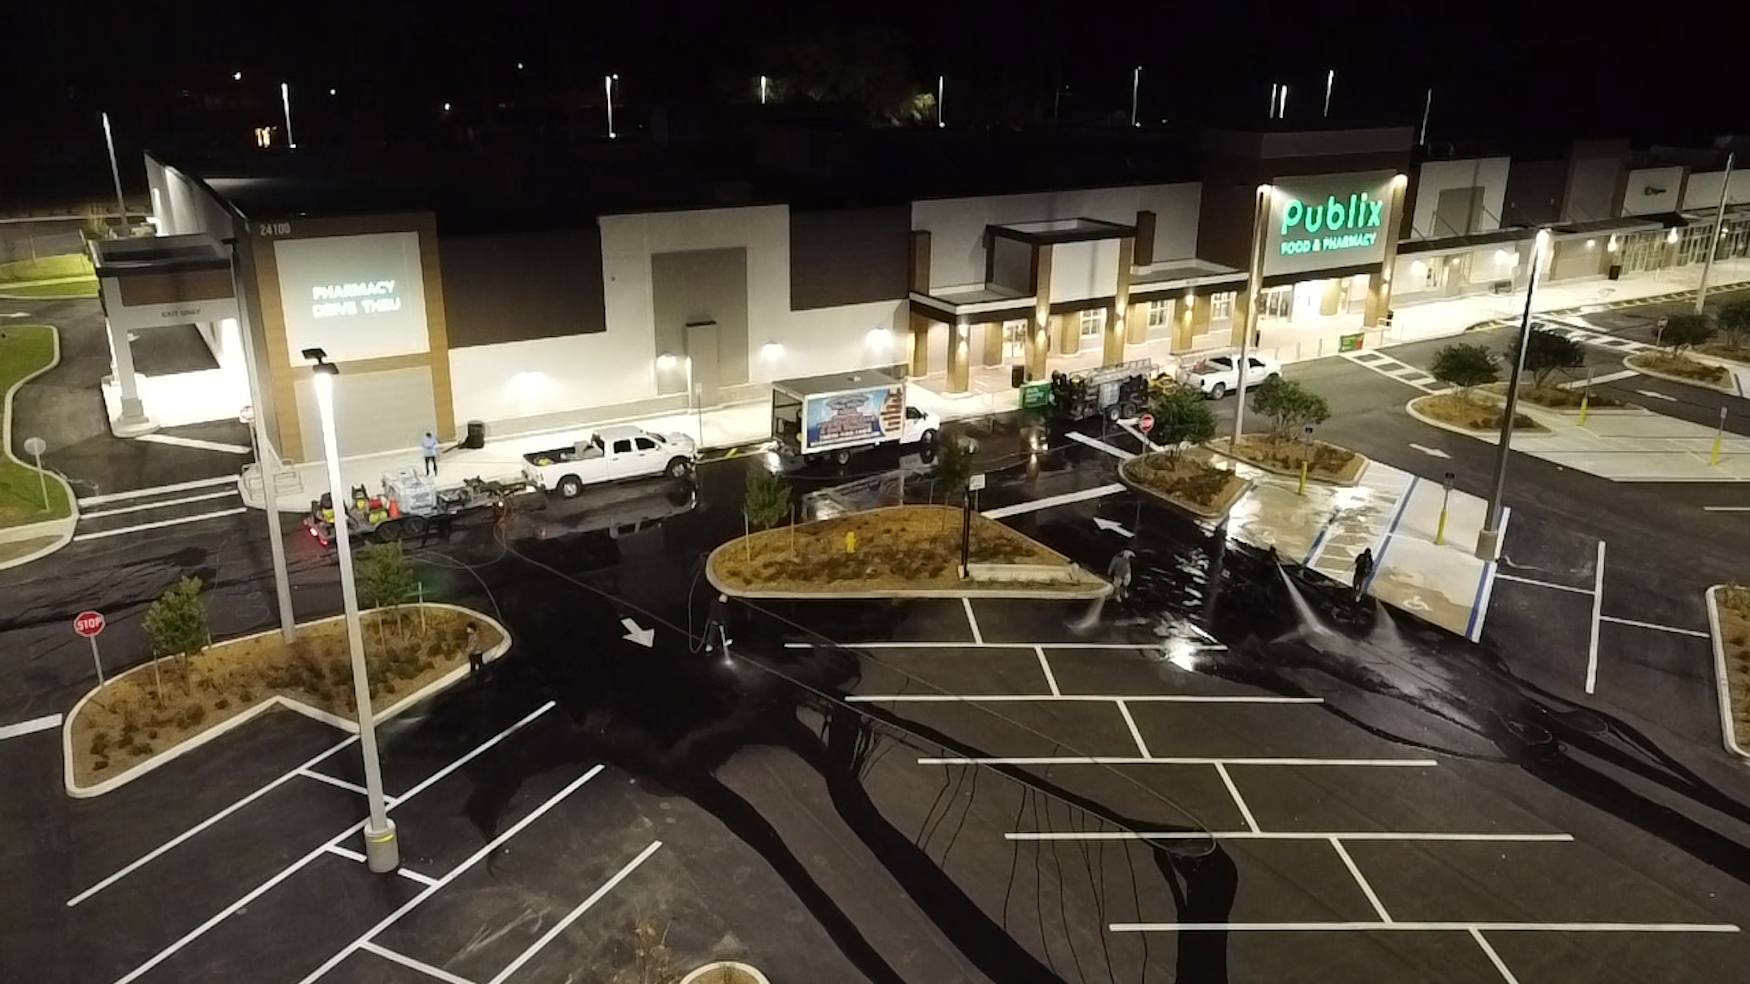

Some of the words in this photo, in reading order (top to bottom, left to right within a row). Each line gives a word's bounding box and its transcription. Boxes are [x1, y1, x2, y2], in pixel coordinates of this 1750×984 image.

[1281, 192, 1383, 235] Publix
[259, 222, 291, 236] 24100
[1280, 239, 1311, 255] FOOD
[1312, 238, 1321, 251] &
[1323, 232, 1377, 250] PHARMACY
[312, 280, 395, 300] PHARMACY
[312, 301, 357, 318] DRIVE
[361, 297, 401, 314] THRU
[77, 616, 102, 631] STOP
